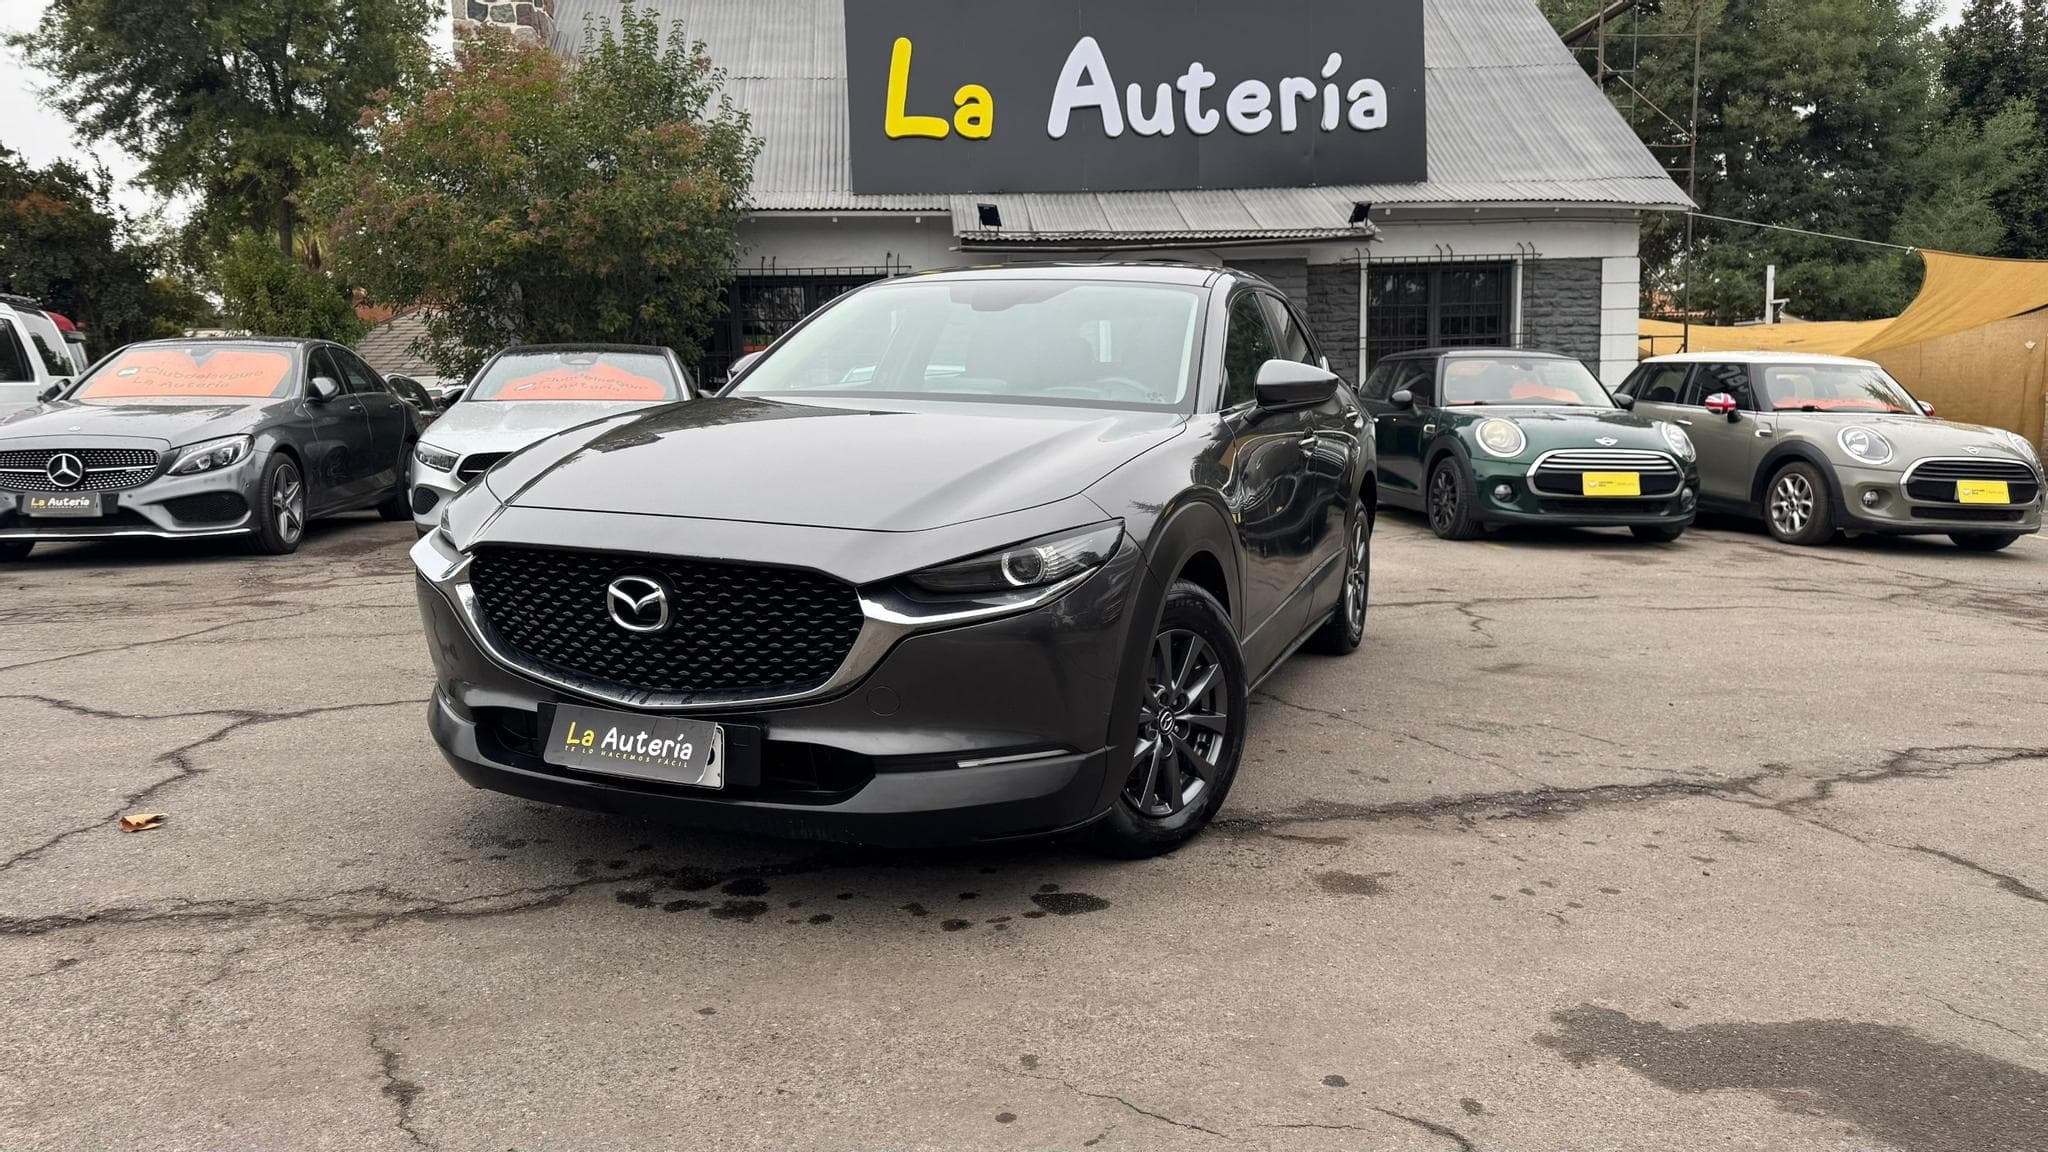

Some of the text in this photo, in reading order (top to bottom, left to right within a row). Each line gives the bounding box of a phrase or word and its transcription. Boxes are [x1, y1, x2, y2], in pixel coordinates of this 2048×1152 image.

[884, 35, 1388, 138] La Autería
[31, 496, 90, 506] La Autería
[566, 721, 693, 761] La Autería
[600, 750, 651, 763] HACEMOS
